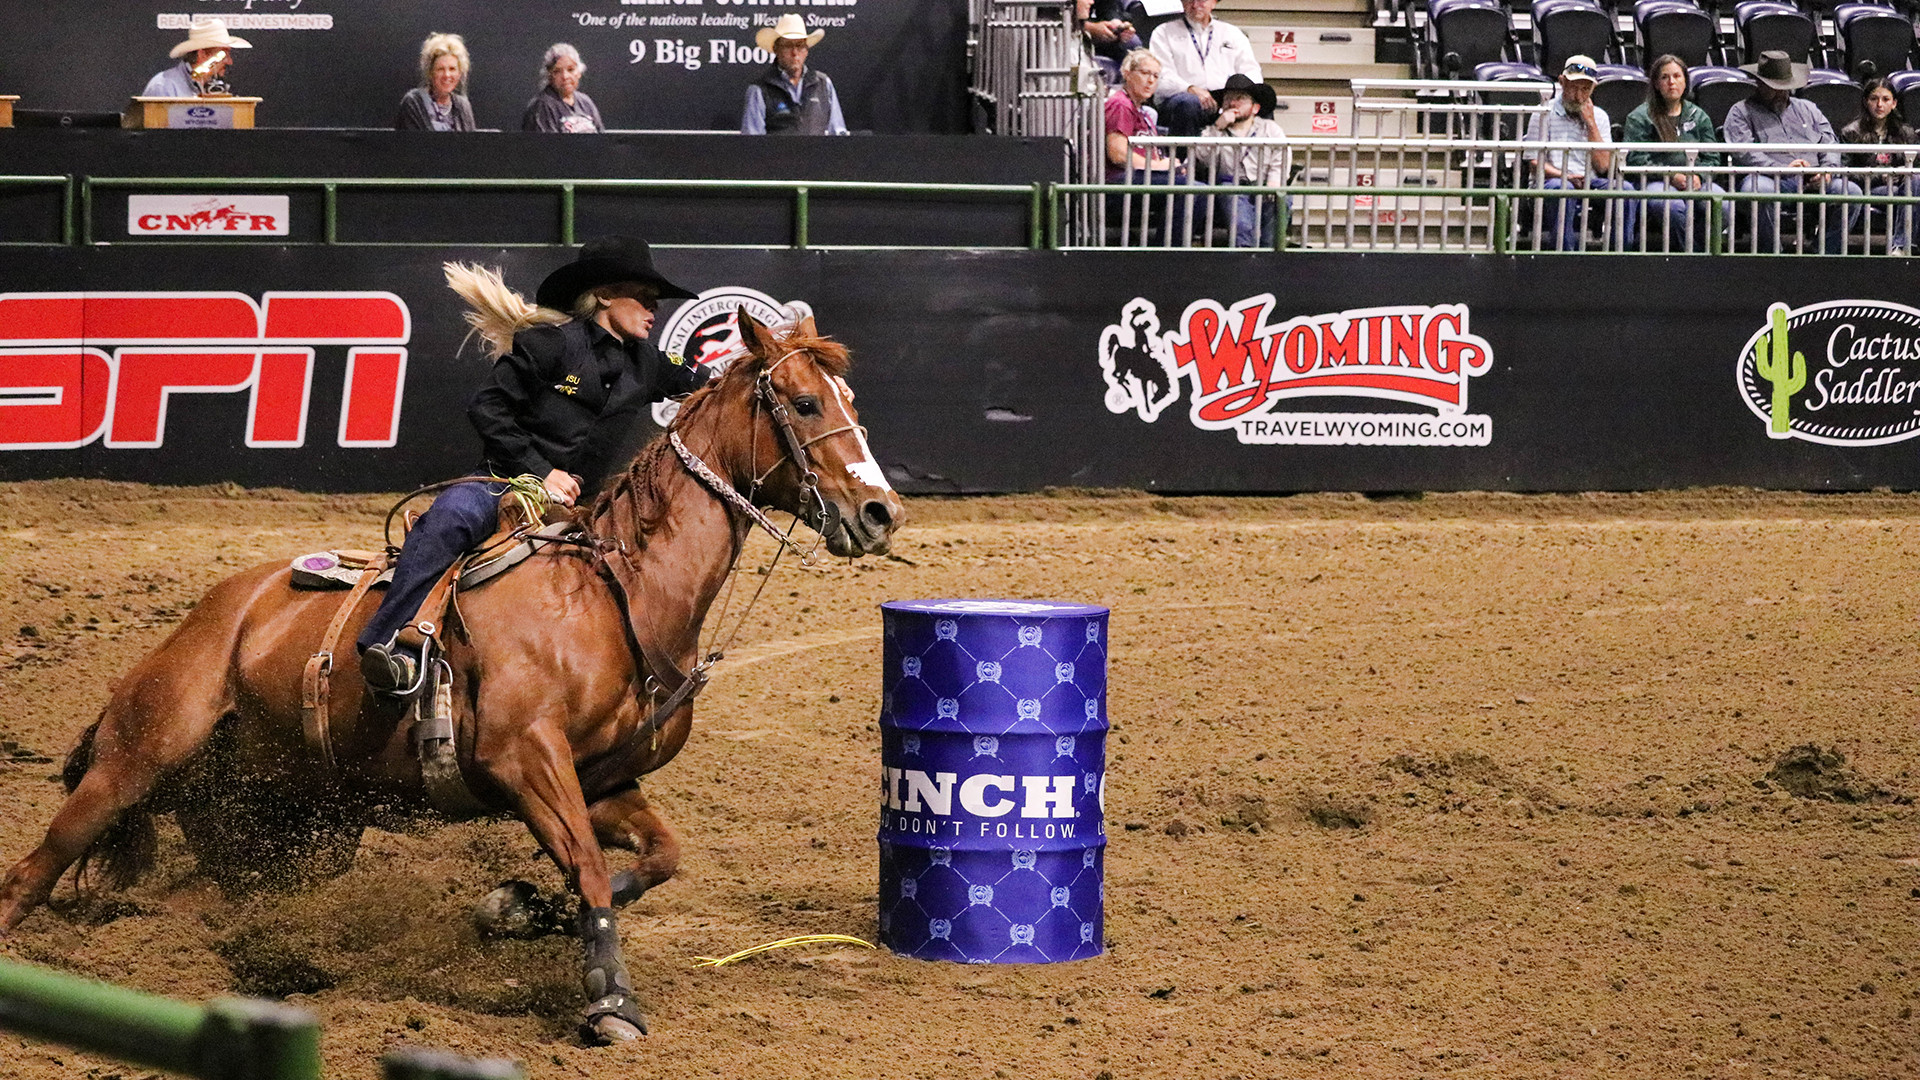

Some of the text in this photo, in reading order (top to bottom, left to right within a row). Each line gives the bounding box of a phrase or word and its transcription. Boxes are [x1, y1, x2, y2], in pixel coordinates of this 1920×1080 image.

[160, 16, 192, 27] REAL
[243, 16, 331, 27] INVESTMENTS
[608, 13, 626, 29] of
[626, 13, 647, 26] the
[650, 13, 697, 26] nations
[701, 13, 749, 29] leading
[1280, 32, 1289, 43] 7
[629, 39, 646, 64] 9
[655, 39, 701, 70] Big
[1320, 102, 1330, 114] 6
[1361, 175, 1372, 186] 5
[1827, 323, 1920, 368] Cactus
[0, 291, 411, 448] SPN
[1804, 368, 1920, 413] Saddler
[1242, 420, 1486, 438] TRAVELWYOMING.COM
[900, 816, 963, 836] DON'T
